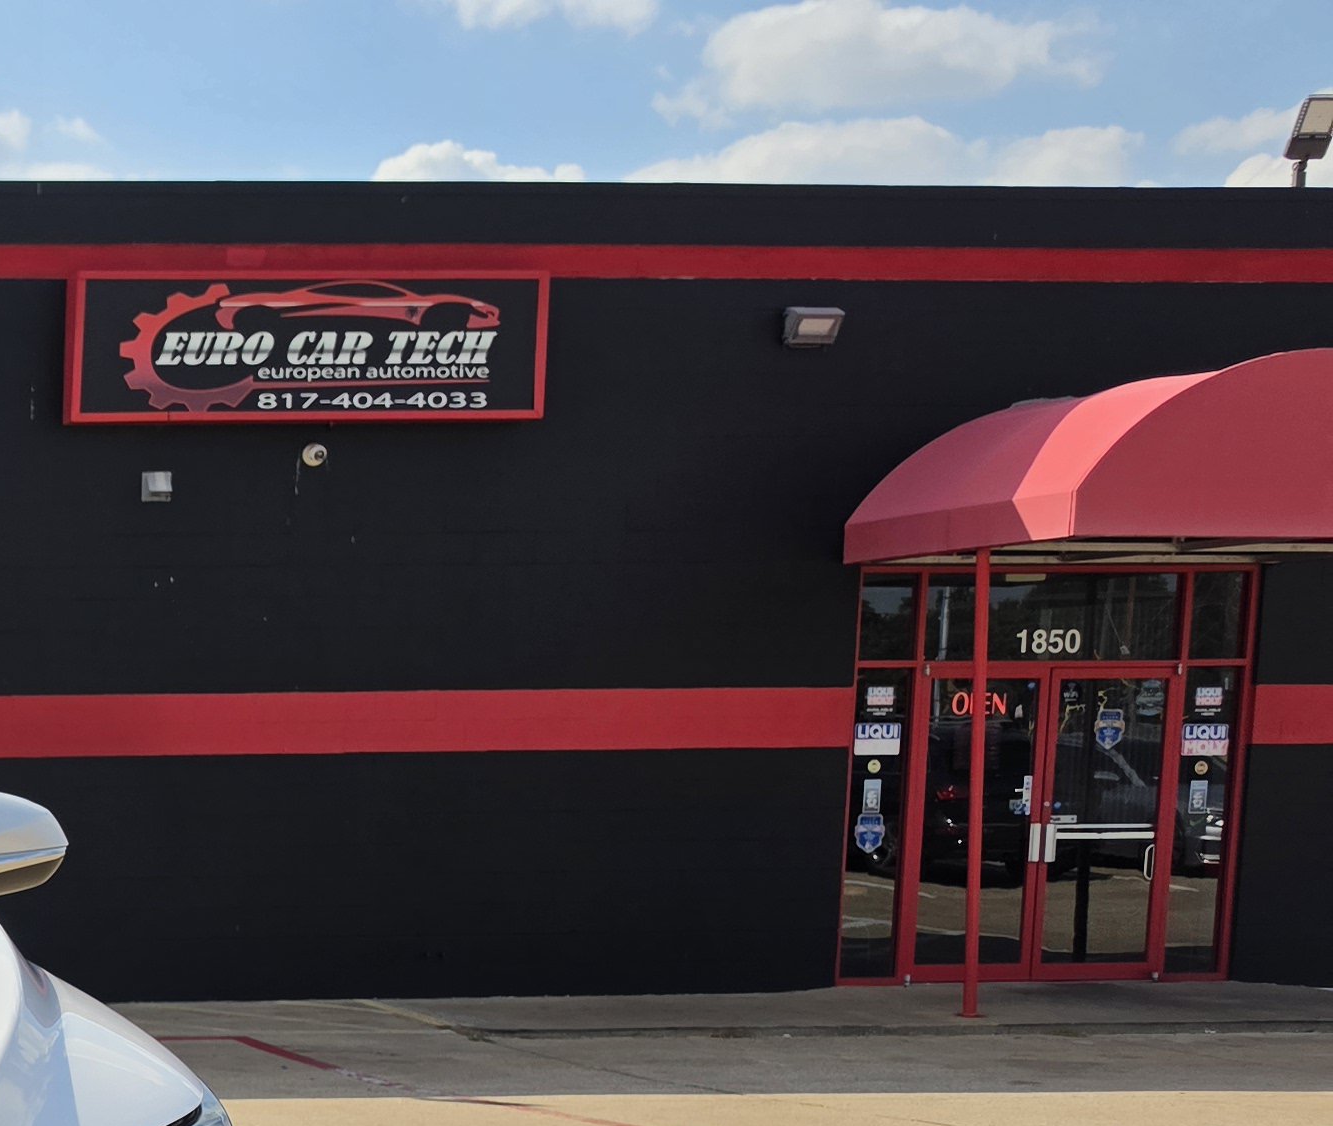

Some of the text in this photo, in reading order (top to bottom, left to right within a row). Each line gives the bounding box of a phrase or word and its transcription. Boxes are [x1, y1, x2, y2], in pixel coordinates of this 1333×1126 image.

[155, 330, 498, 366] EURO CAR TECH
[257, 363, 490, 383] european automotive
[257, 391, 488, 410] 817-404-4033
[1016, 629, 1081, 654] 1850
[951, 691, 1008, 716] OEN
[857, 724, 900, 739] LIQUI
[1184, 725, 1227, 740] LIQUI
[1183, 740, 1227, 755] MOLY
